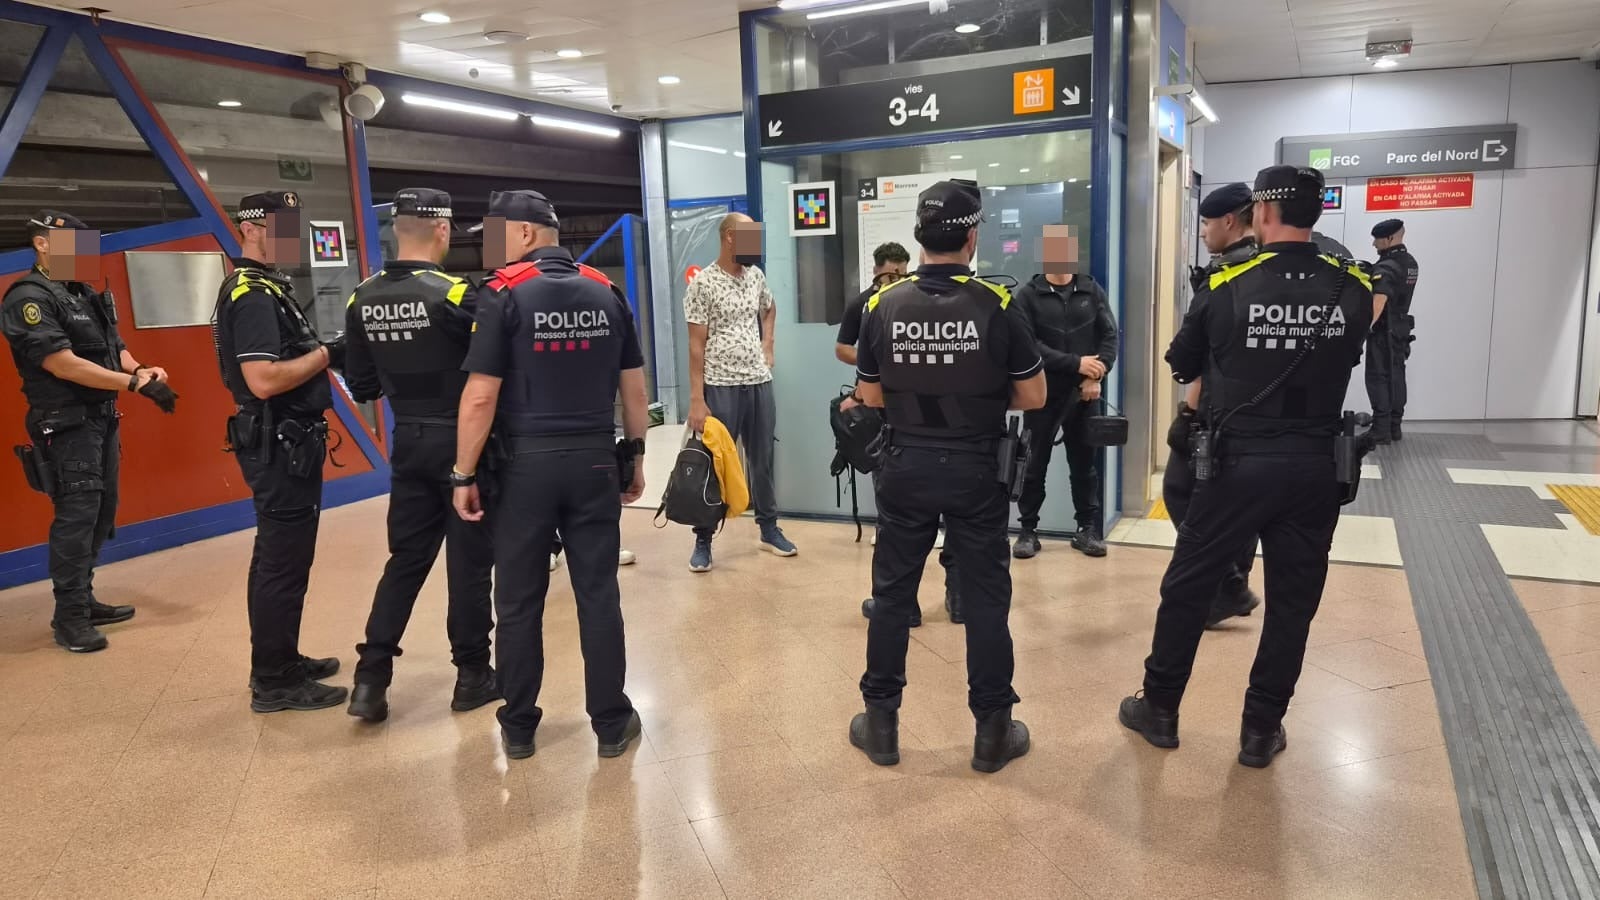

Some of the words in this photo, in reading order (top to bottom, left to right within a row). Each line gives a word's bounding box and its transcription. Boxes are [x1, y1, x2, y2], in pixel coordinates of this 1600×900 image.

[904, 84, 923, 95] vies
[888, 93, 940, 126] 3-4
[1333, 155, 1360, 166] FGC
[1386, 152, 1418, 164] Parc
[1421, 150, 1442, 162] del
[1445, 148, 1479, 161] Nord
[860, 188, 874, 198] 3-4
[1433, 191, 1465, 199] ACTIVADA
[1411, 199, 1437, 207] PASSAR
[361, 301, 428, 322] POLICIA
[534, 309, 610, 329] POLICIA
[364, 321, 390, 333] policia
[390, 317, 431, 330] municipal
[892, 320, 979, 340] POLICIA
[1247, 323, 1286, 337] policia
[1288, 324, 1346, 339] munipal
[534, 331, 568, 339] mossos
[568, 327, 610, 338] d'esquadra
[892, 340, 926, 352] policia
[928, 339, 980, 353] municipal
